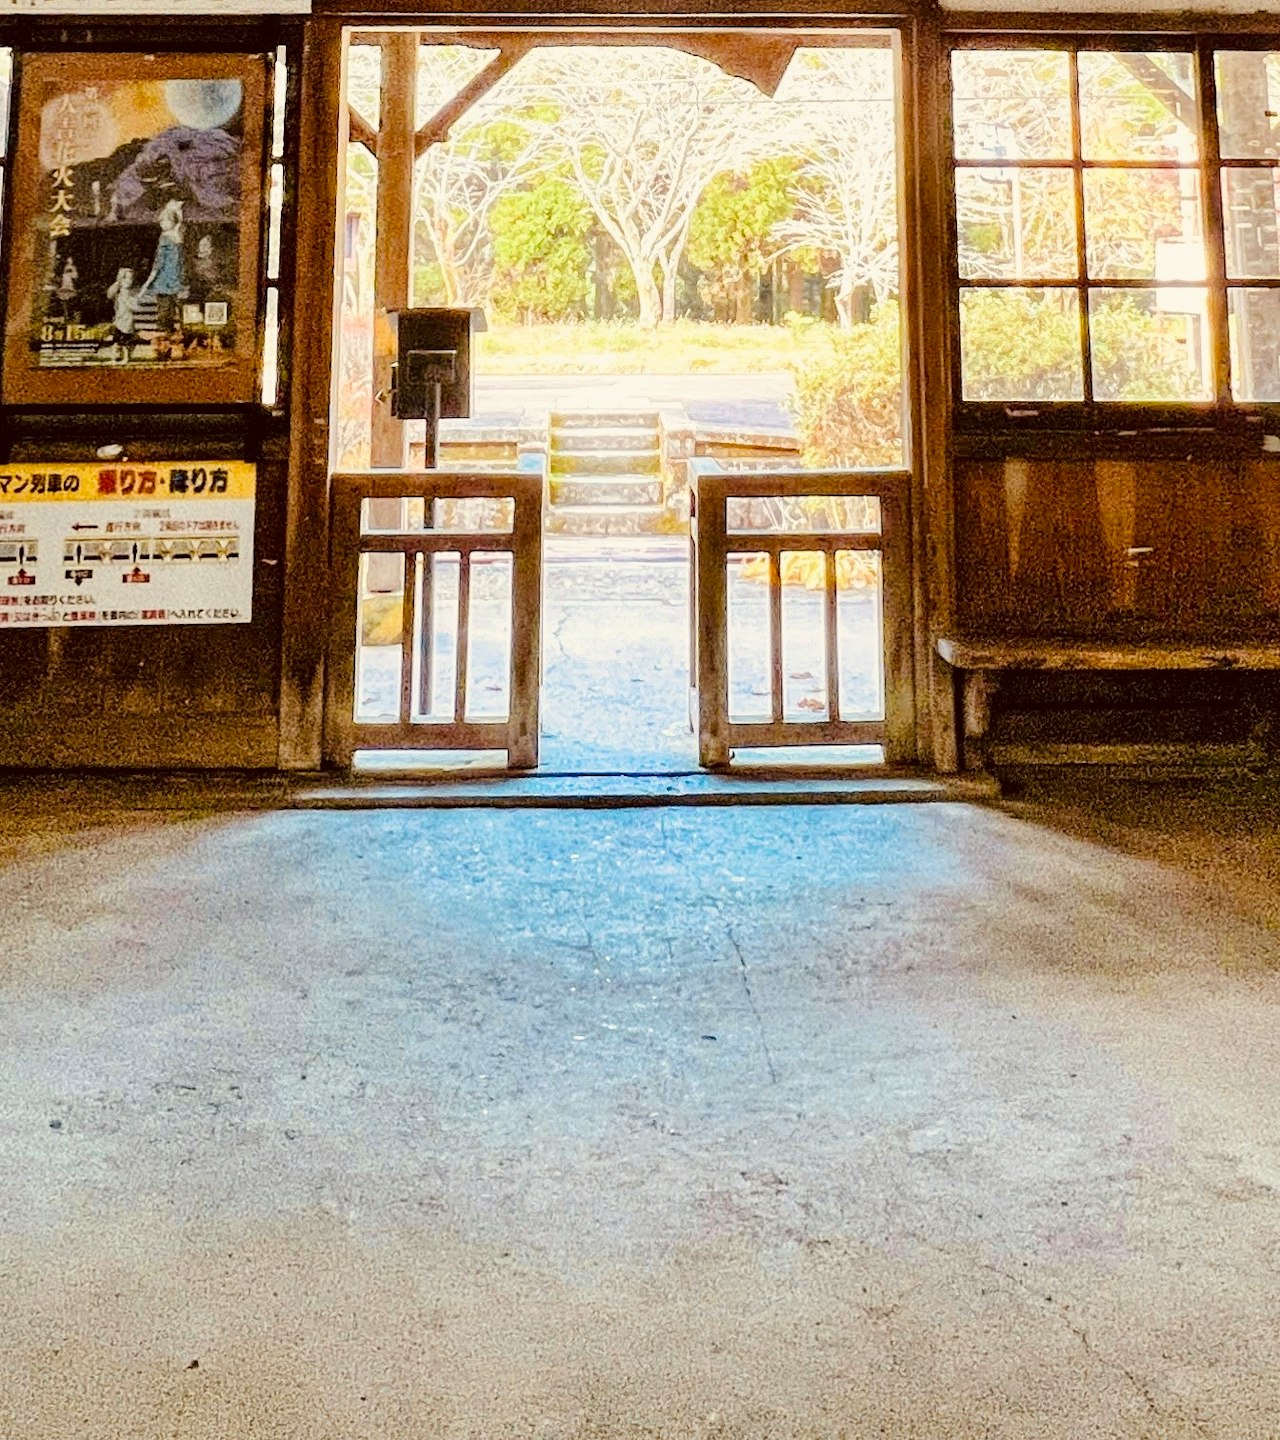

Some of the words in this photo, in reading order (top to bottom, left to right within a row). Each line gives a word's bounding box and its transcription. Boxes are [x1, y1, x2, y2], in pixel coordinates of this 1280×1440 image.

[98, 468, 229, 495] 乗り方・降り方
